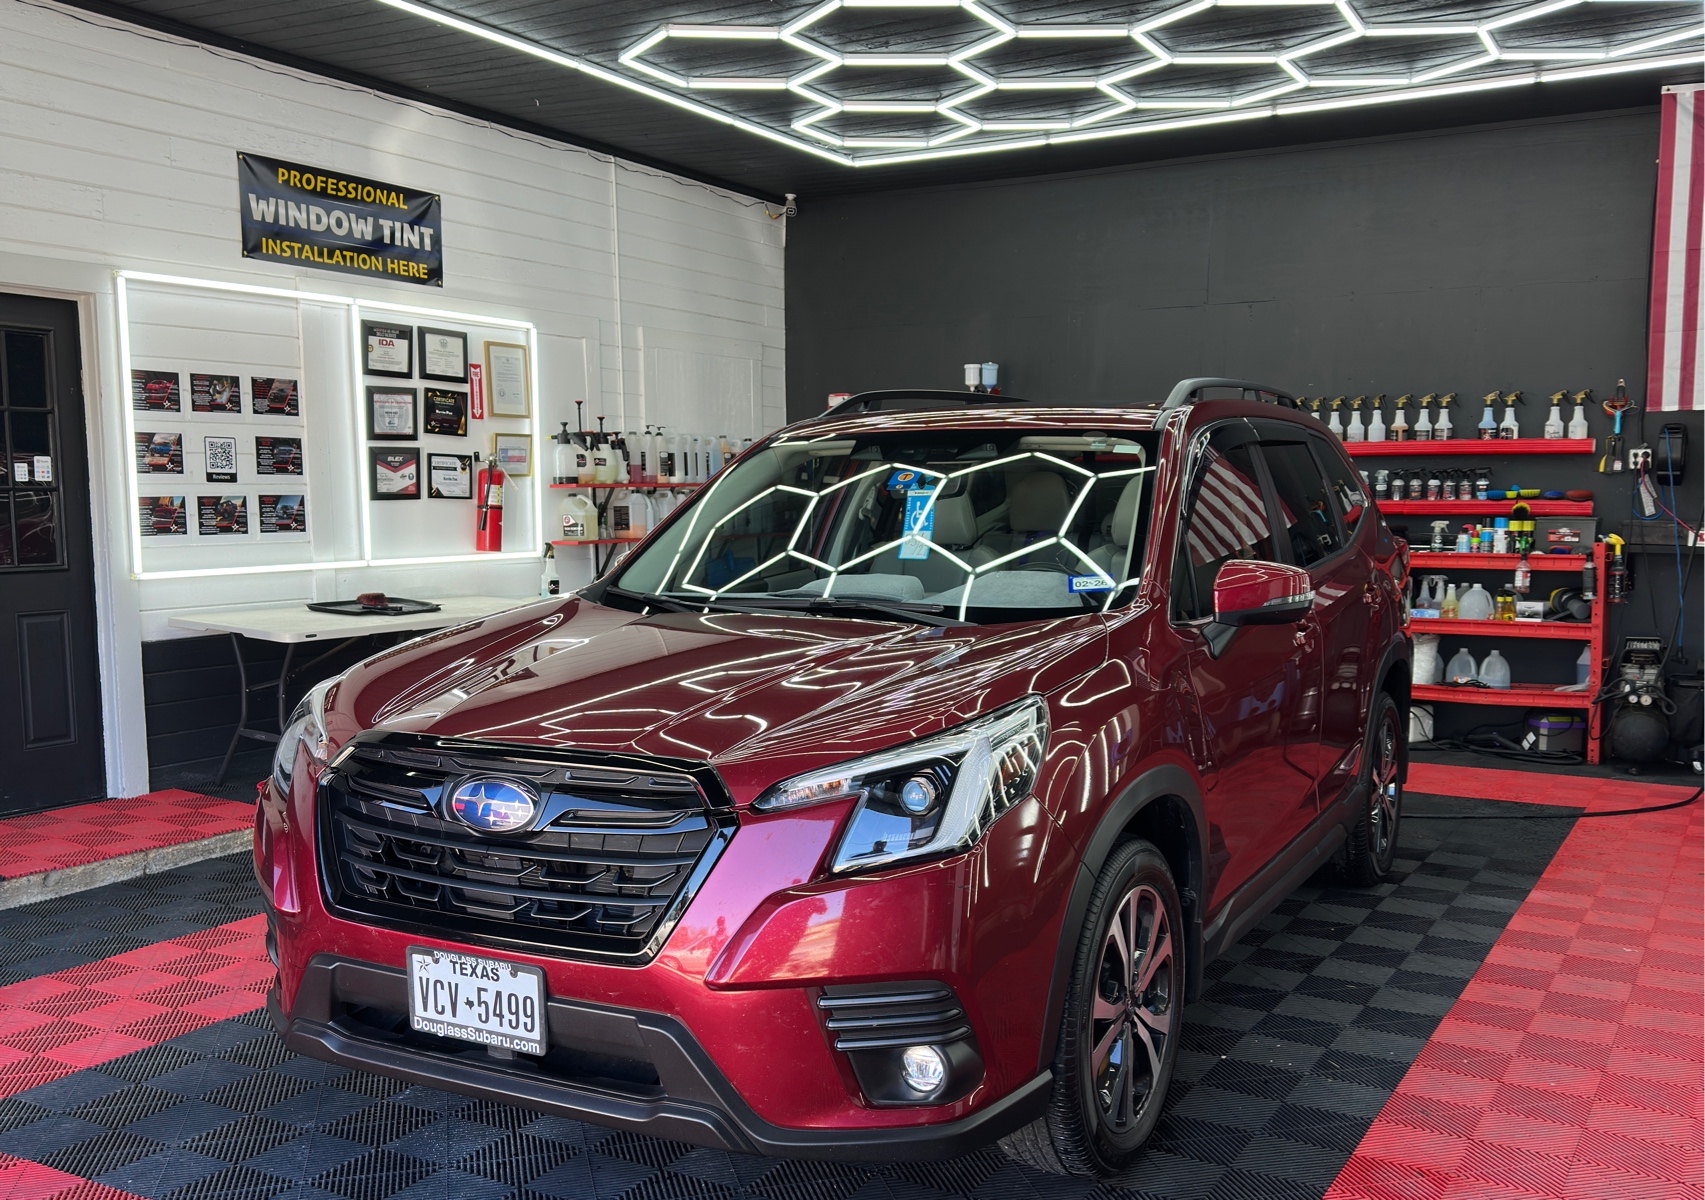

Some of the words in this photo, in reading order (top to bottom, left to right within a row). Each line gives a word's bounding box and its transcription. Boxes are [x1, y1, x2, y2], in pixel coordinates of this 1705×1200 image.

[277, 167, 408, 210] PROFESSIONAL
[248, 193, 374, 241] WINDOW
[379, 218, 434, 251] TINT
[261, 237, 383, 272] INSTALLATION
[387, 258, 428, 279] HERE
[378, 339, 395, 347] IDA
[433, 950, 477, 965] DOUGLASS
[478, 958, 512, 971] SUBARU
[450, 961, 500, 982] TEXAS
[414, 1016, 540, 1054] DouglassSubaru.com
